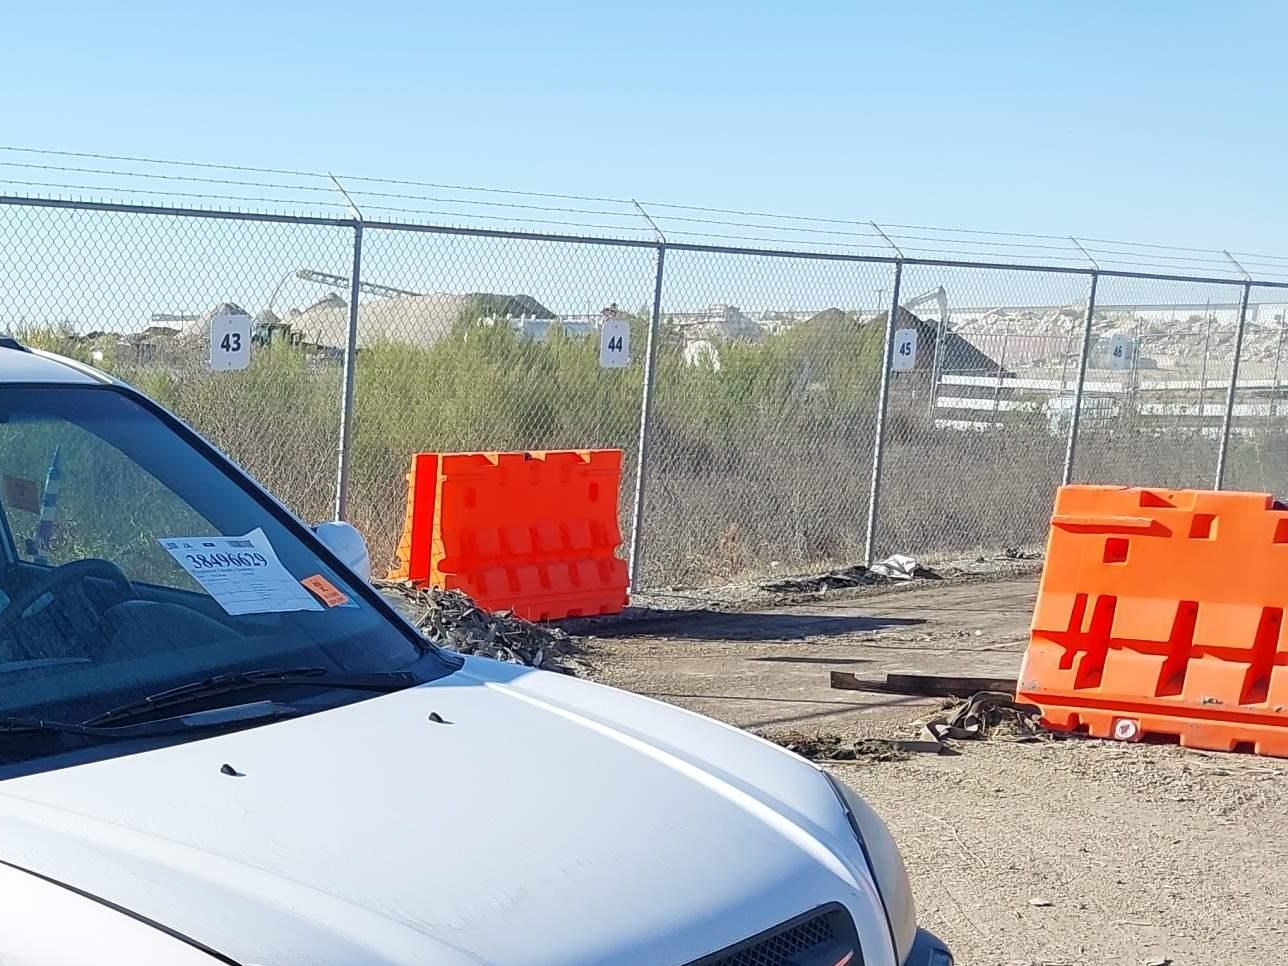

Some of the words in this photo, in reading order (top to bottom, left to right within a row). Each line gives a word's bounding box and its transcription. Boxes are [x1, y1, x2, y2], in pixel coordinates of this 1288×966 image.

[221, 333, 241, 352] 43
[608, 336, 622, 352] 44
[899, 342, 911, 356] 45
[1113, 345, 1122, 358] 46
[186, 552, 267, 568] 38496629
